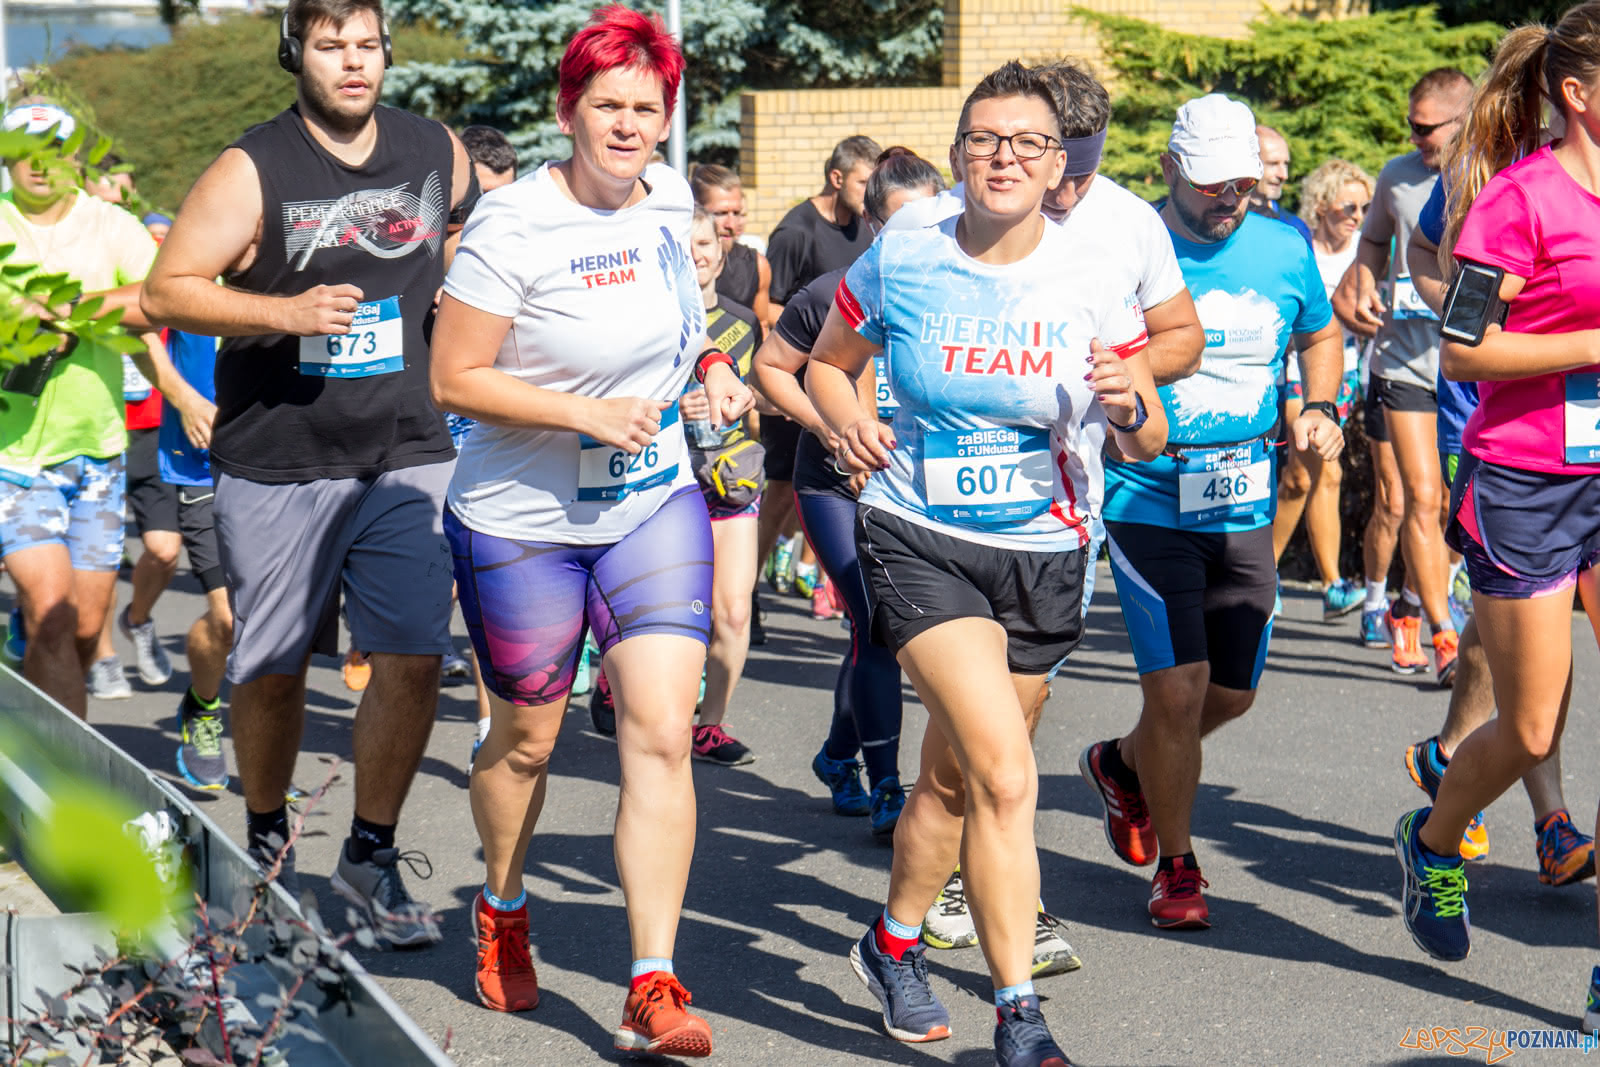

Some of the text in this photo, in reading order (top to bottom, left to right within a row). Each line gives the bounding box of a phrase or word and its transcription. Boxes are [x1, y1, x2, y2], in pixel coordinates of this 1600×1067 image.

[288, 193, 404, 222] PERFRMANCE
[570, 248, 642, 274] HERNIK
[582, 268, 636, 289] TEAM
[921, 313, 1069, 348] HERNIK
[1206, 333, 1222, 343] KO
[327, 331, 376, 357] 673
[942, 345, 1053, 378] TEAM
[957, 430, 1019, 446] zaBIEGaj
[958, 444, 1019, 456] o FUNdusze
[608, 442, 658, 478] 626
[1206, 464, 1212, 472] o
[956, 463, 1018, 496] 607
[1202, 474, 1248, 501] 436
